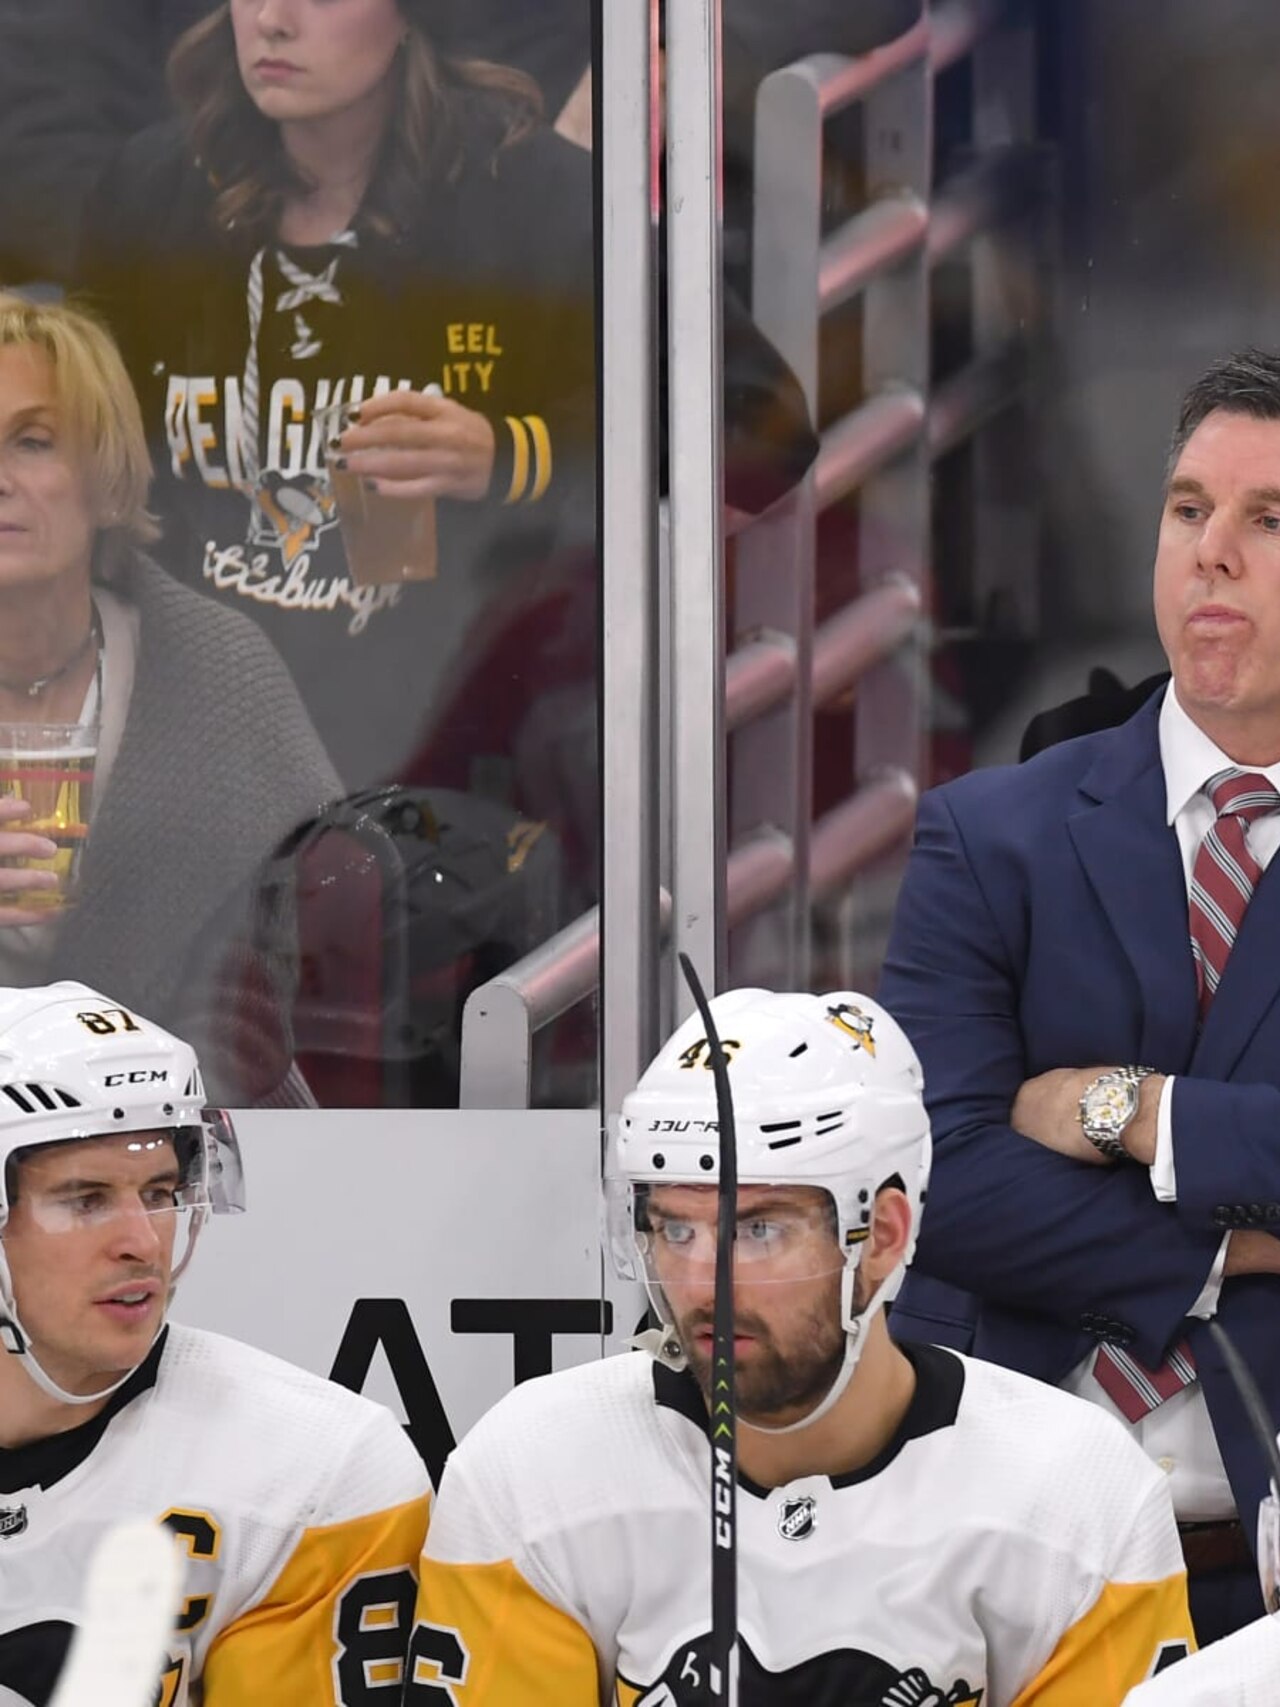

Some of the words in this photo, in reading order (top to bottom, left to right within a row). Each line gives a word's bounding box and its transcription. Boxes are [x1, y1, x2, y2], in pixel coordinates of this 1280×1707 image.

[77, 1008, 142, 1035] 87
[104, 1070, 168, 1088] CCM
[715, 1447, 733, 1550] CCM
